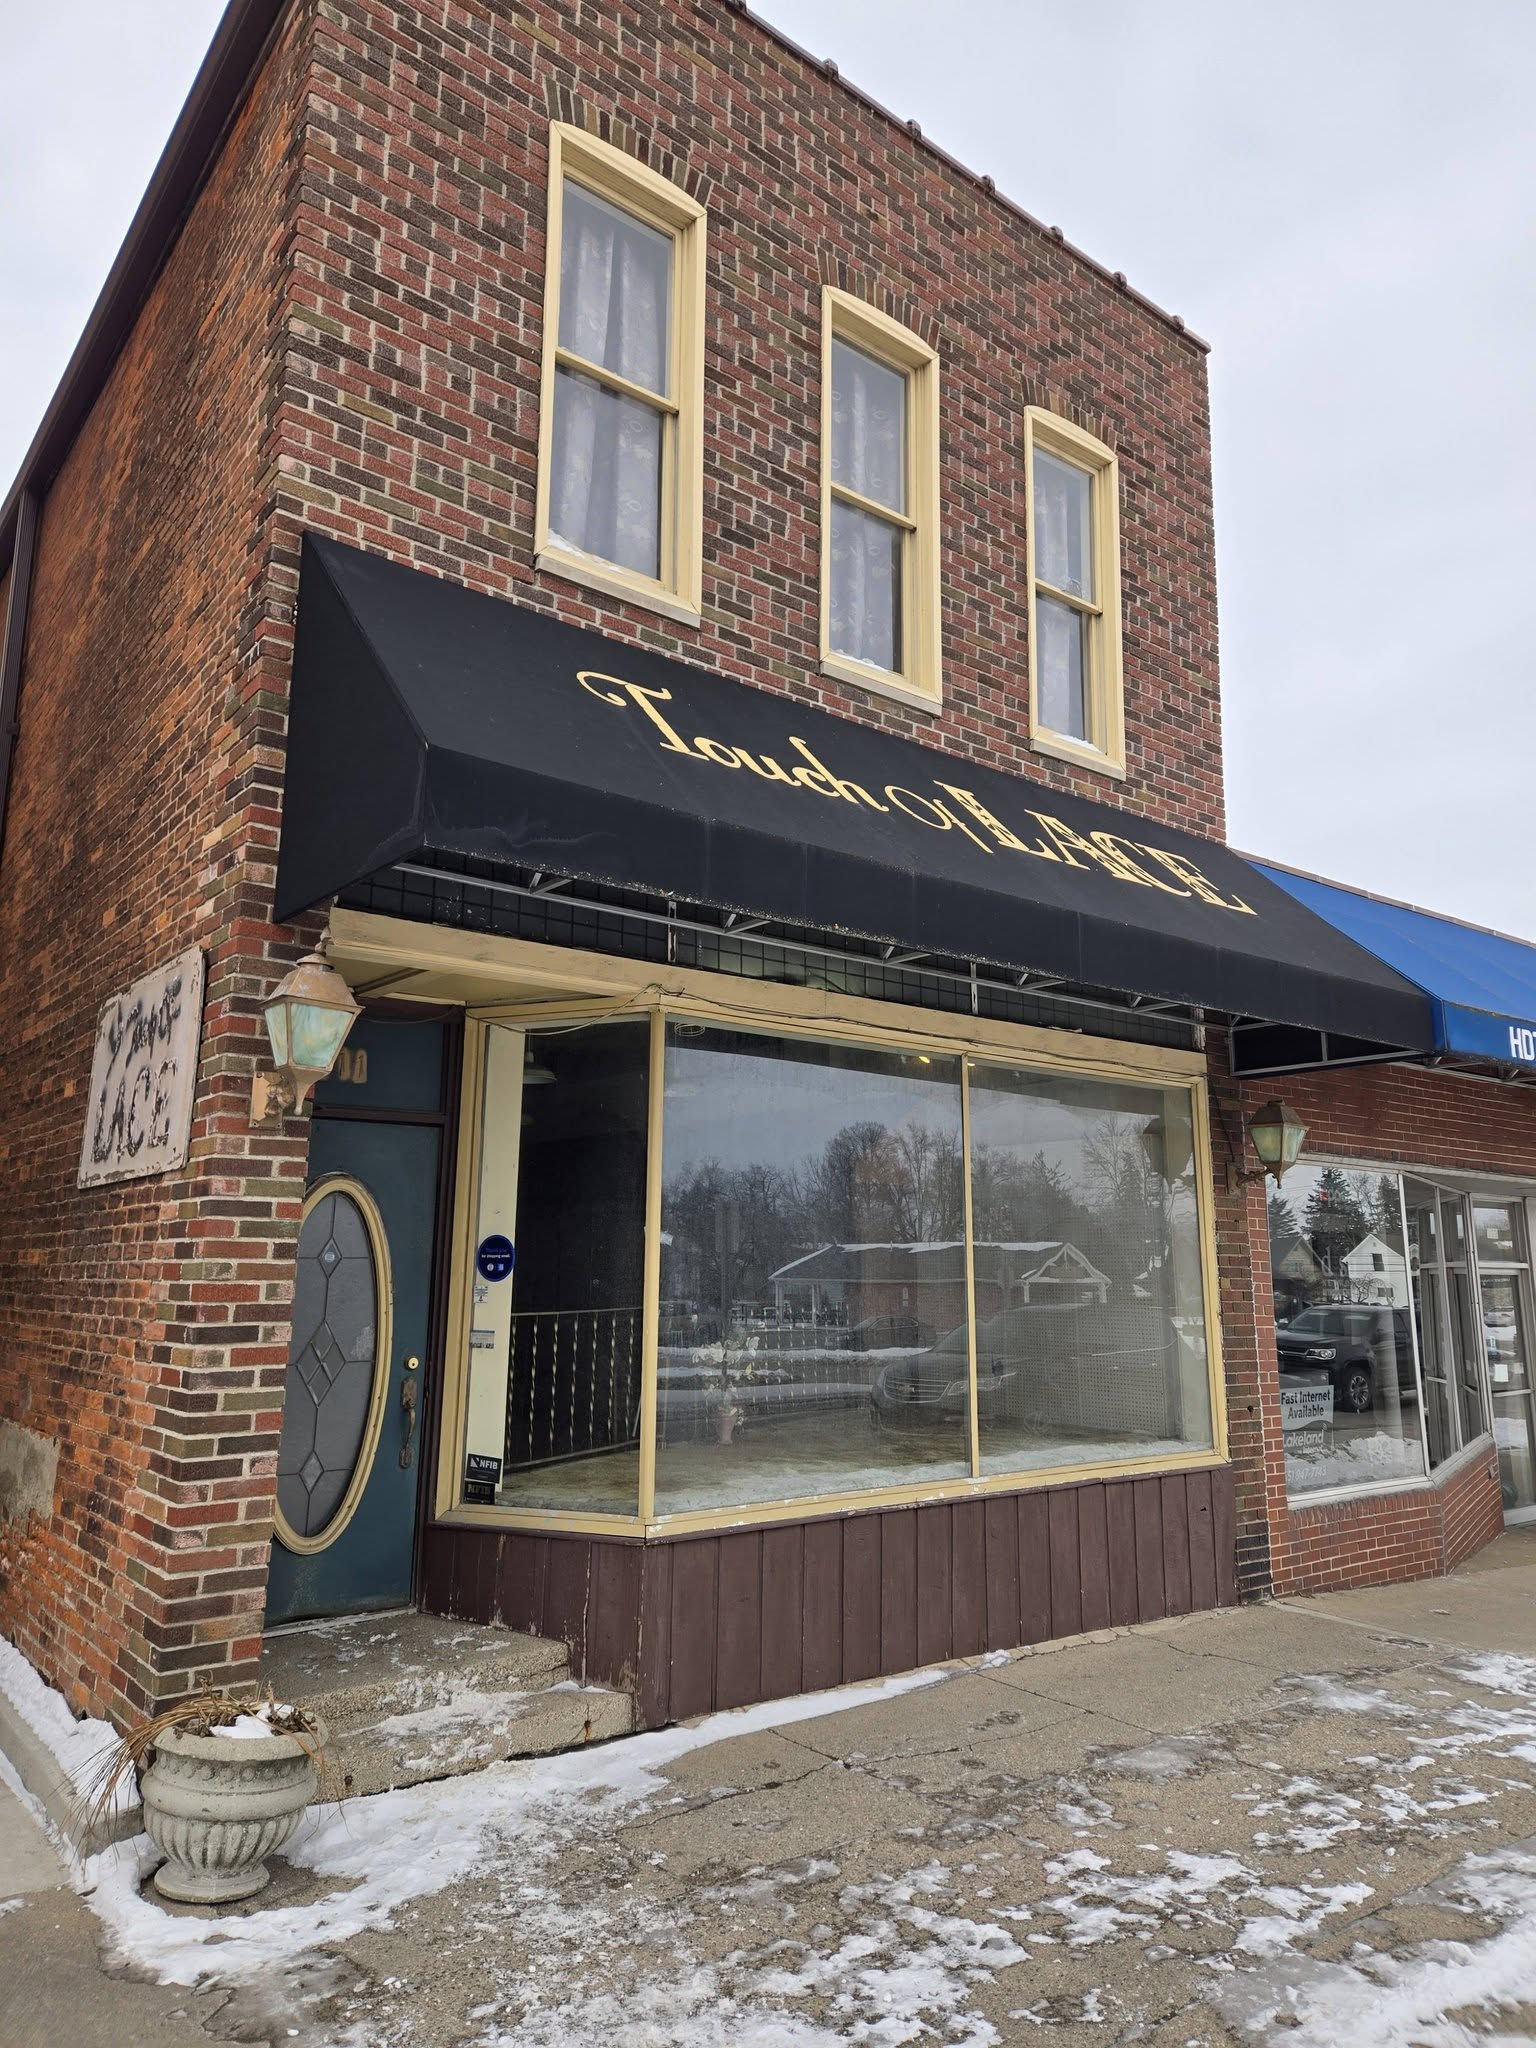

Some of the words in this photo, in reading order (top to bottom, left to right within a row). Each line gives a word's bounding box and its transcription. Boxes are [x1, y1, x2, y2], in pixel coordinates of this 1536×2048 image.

[576, 670, 889, 813] Touch
[934, 780, 1257, 915] LACE
[1281, 1391, 1298, 1405] Fast
[1299, 1388, 1330, 1404] Internet
[1288, 1404, 1324, 1419] Available
[1283, 1430, 1325, 1448] Lakeland
[479, 1459, 498, 1470] NFIB
